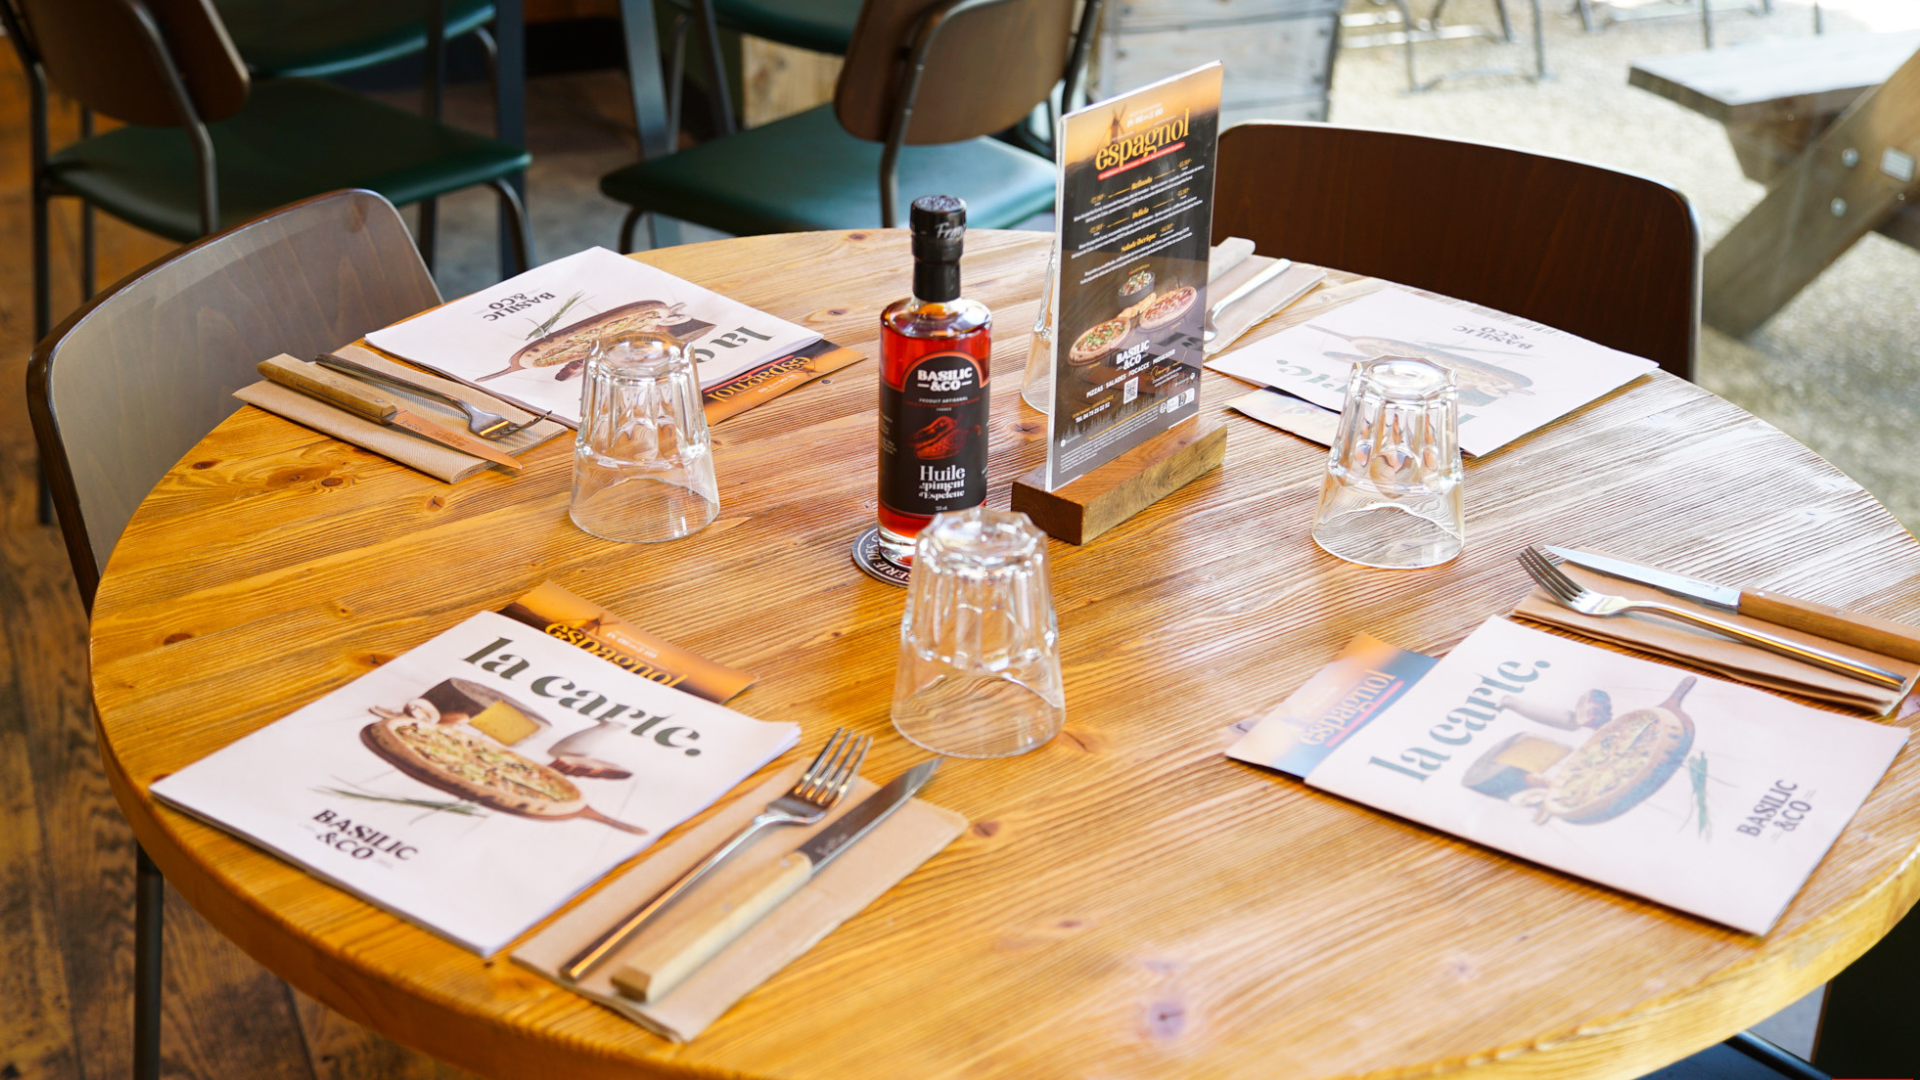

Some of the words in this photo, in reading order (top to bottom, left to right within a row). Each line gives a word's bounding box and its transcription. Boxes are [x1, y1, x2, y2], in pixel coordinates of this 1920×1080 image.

[1095, 106, 1190, 171] espagnol
[483, 292, 556, 321] BASILIC
[489, 293, 527, 310] &CO
[710, 326, 775, 348] la
[1453, 326, 1534, 349] BASILIC
[1116, 340, 1150, 364] BASILIC
[1123, 353, 1142, 370] &CO
[706, 356, 811, 402] espagnol
[917, 366, 973, 381] BASILIC
[930, 380, 961, 392] &CO
[1086, 385, 1104, 398] PIZZAS
[1105, 373, 1127, 388] SALADES
[1128, 362, 1150, 377] FOCACCE
[920, 464, 966, 481] Huile
[924, 479, 965, 492] piment
[460, 636, 530, 682] la
[530, 675, 702, 757] carte.
[1299, 669, 1397, 746] espagnol
[1367, 747, 1451, 783] la
[1429, 660, 1552, 745] carte.
[1736, 779, 1798, 837] BASILIC
[1773, 800, 1812, 832] &CO
[313, 809, 418, 860] BASILIC
[316, 832, 374, 860] &CO
